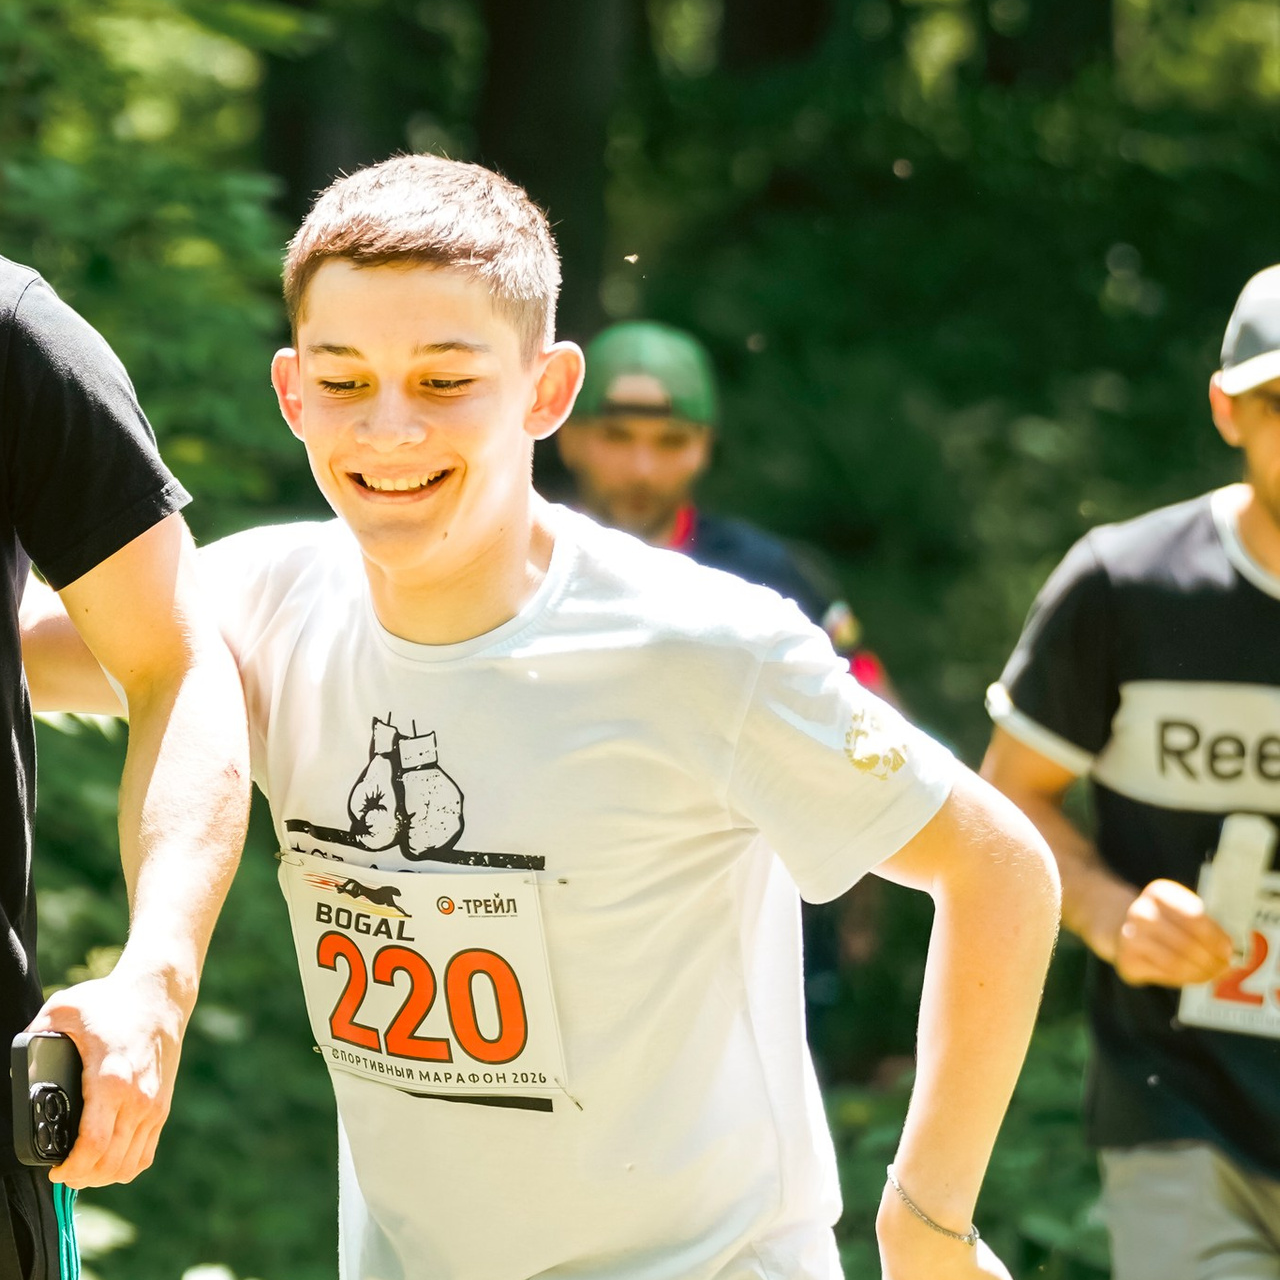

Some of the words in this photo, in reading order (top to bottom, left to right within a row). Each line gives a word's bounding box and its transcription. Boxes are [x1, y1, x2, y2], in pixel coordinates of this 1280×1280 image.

[315, 901, 415, 942] BOGAL
[316, 930, 528, 1065] 220
[331, 1047, 414, 1080] СПОРТИВНЫЙ
[419, 1070, 507, 1084] МАРАФОН
[513, 1071, 547, 1084] 2026
